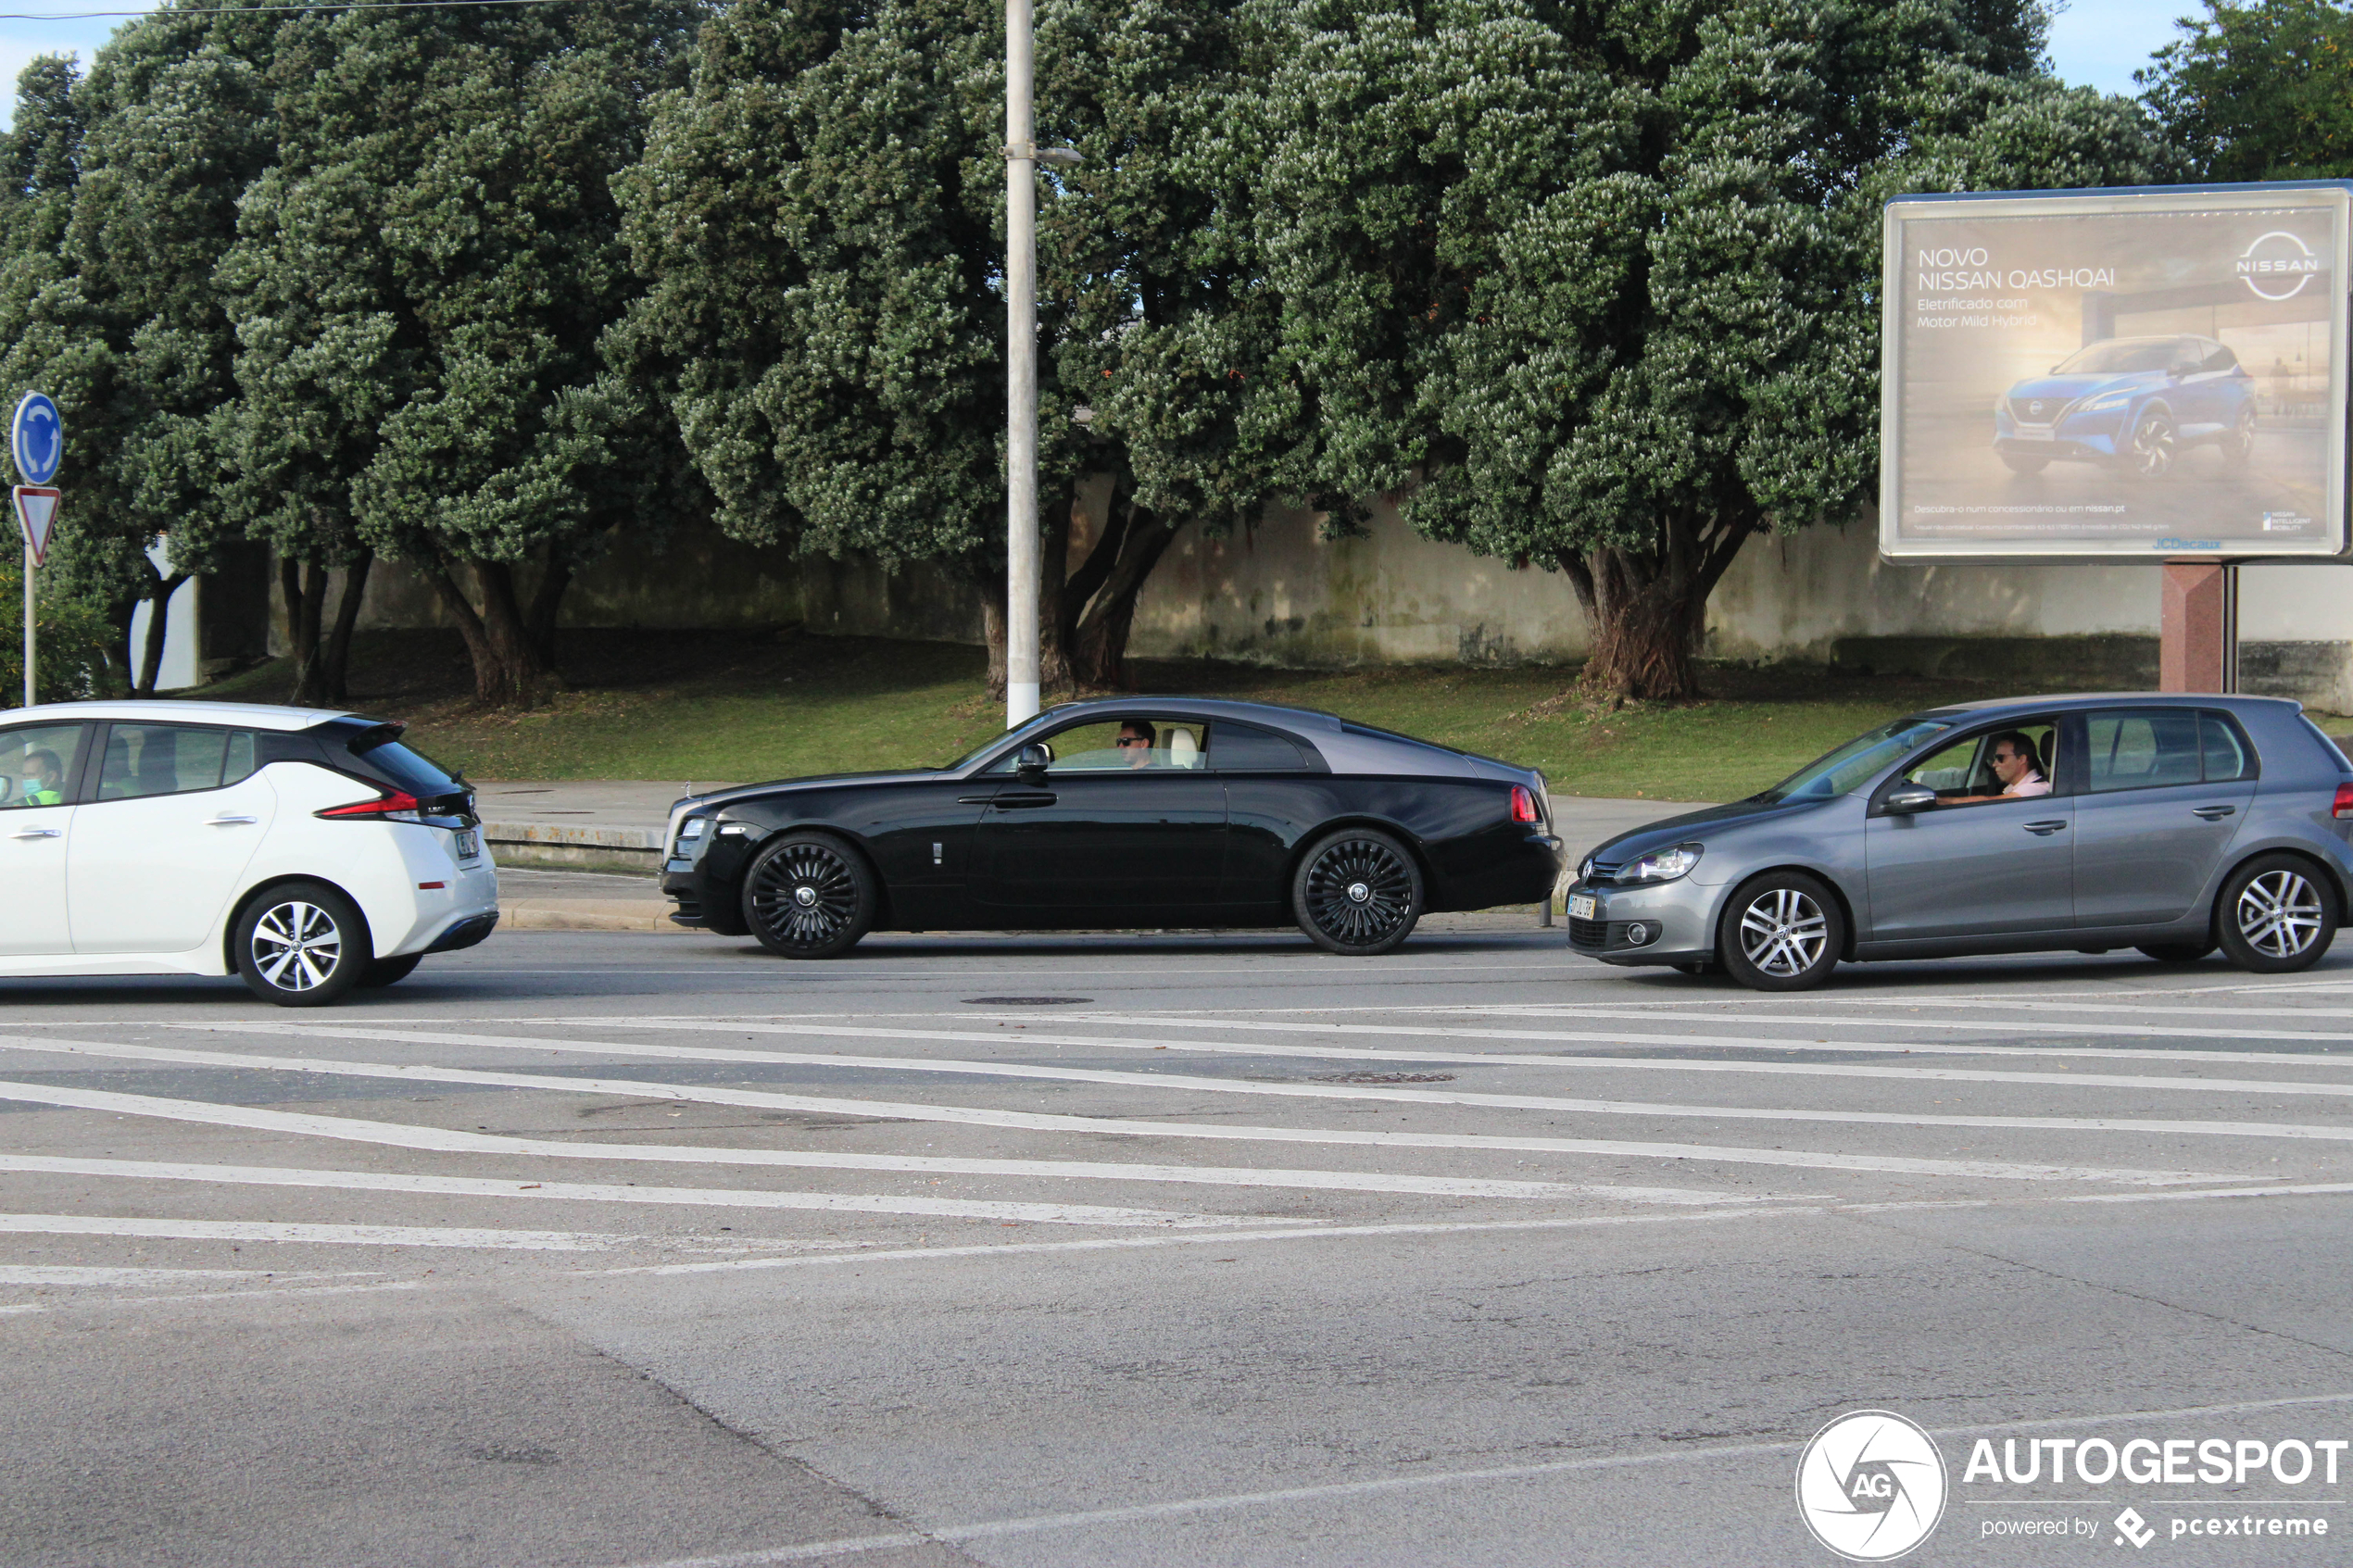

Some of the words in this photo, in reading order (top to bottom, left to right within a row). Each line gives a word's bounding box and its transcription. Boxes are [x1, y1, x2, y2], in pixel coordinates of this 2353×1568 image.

[1919, 247, 1989, 268] NOVO
[2236, 259, 2318, 272] NISSAN
[1918, 270, 2001, 291] NISSAN
[2007, 268, 2115, 290] QASHQAI
[1917, 295, 1994, 311] Eletrificado
[1995, 297, 2028, 309] com
[1917, 315, 1958, 328] Motor
[1960, 314, 1989, 328] Mild
[1992, 313, 2037, 328] Hybrid
[1914, 505, 1964, 513] Descubra-o
[1987, 504, 2054, 513] concessionário
[2085, 504, 2126, 514] nissan.pt
[2152, 538, 2221, 549] JCDecaux
